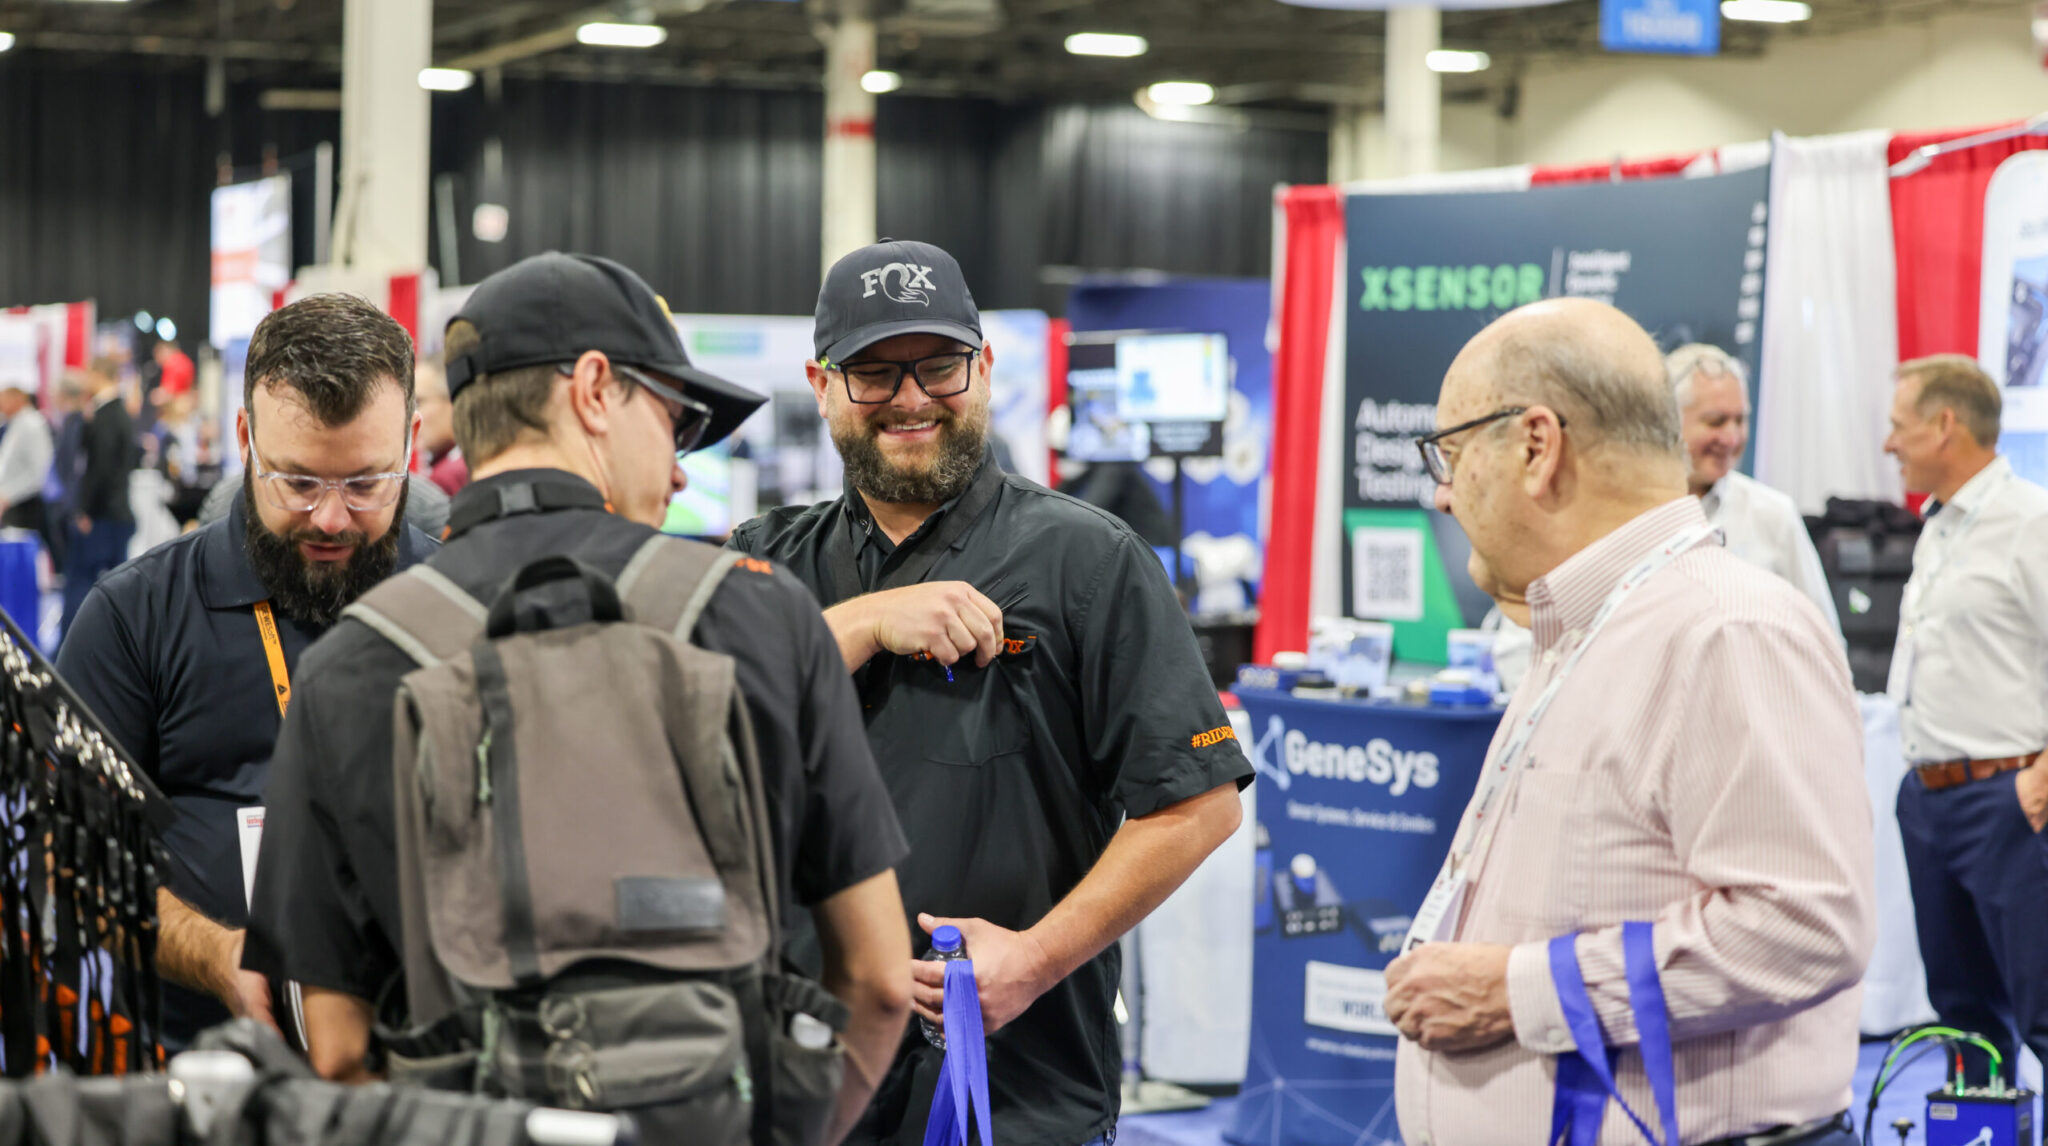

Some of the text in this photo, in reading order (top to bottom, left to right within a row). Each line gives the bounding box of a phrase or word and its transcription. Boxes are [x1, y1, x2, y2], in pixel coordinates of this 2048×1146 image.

[860, 262, 937, 306] FOX
[1360, 264, 1544, 311] XSENSOR
[1356, 433, 1424, 471] Desig
[1285, 729, 1439, 796] GeneSys
[1342, 999, 1388, 1020] WORL
